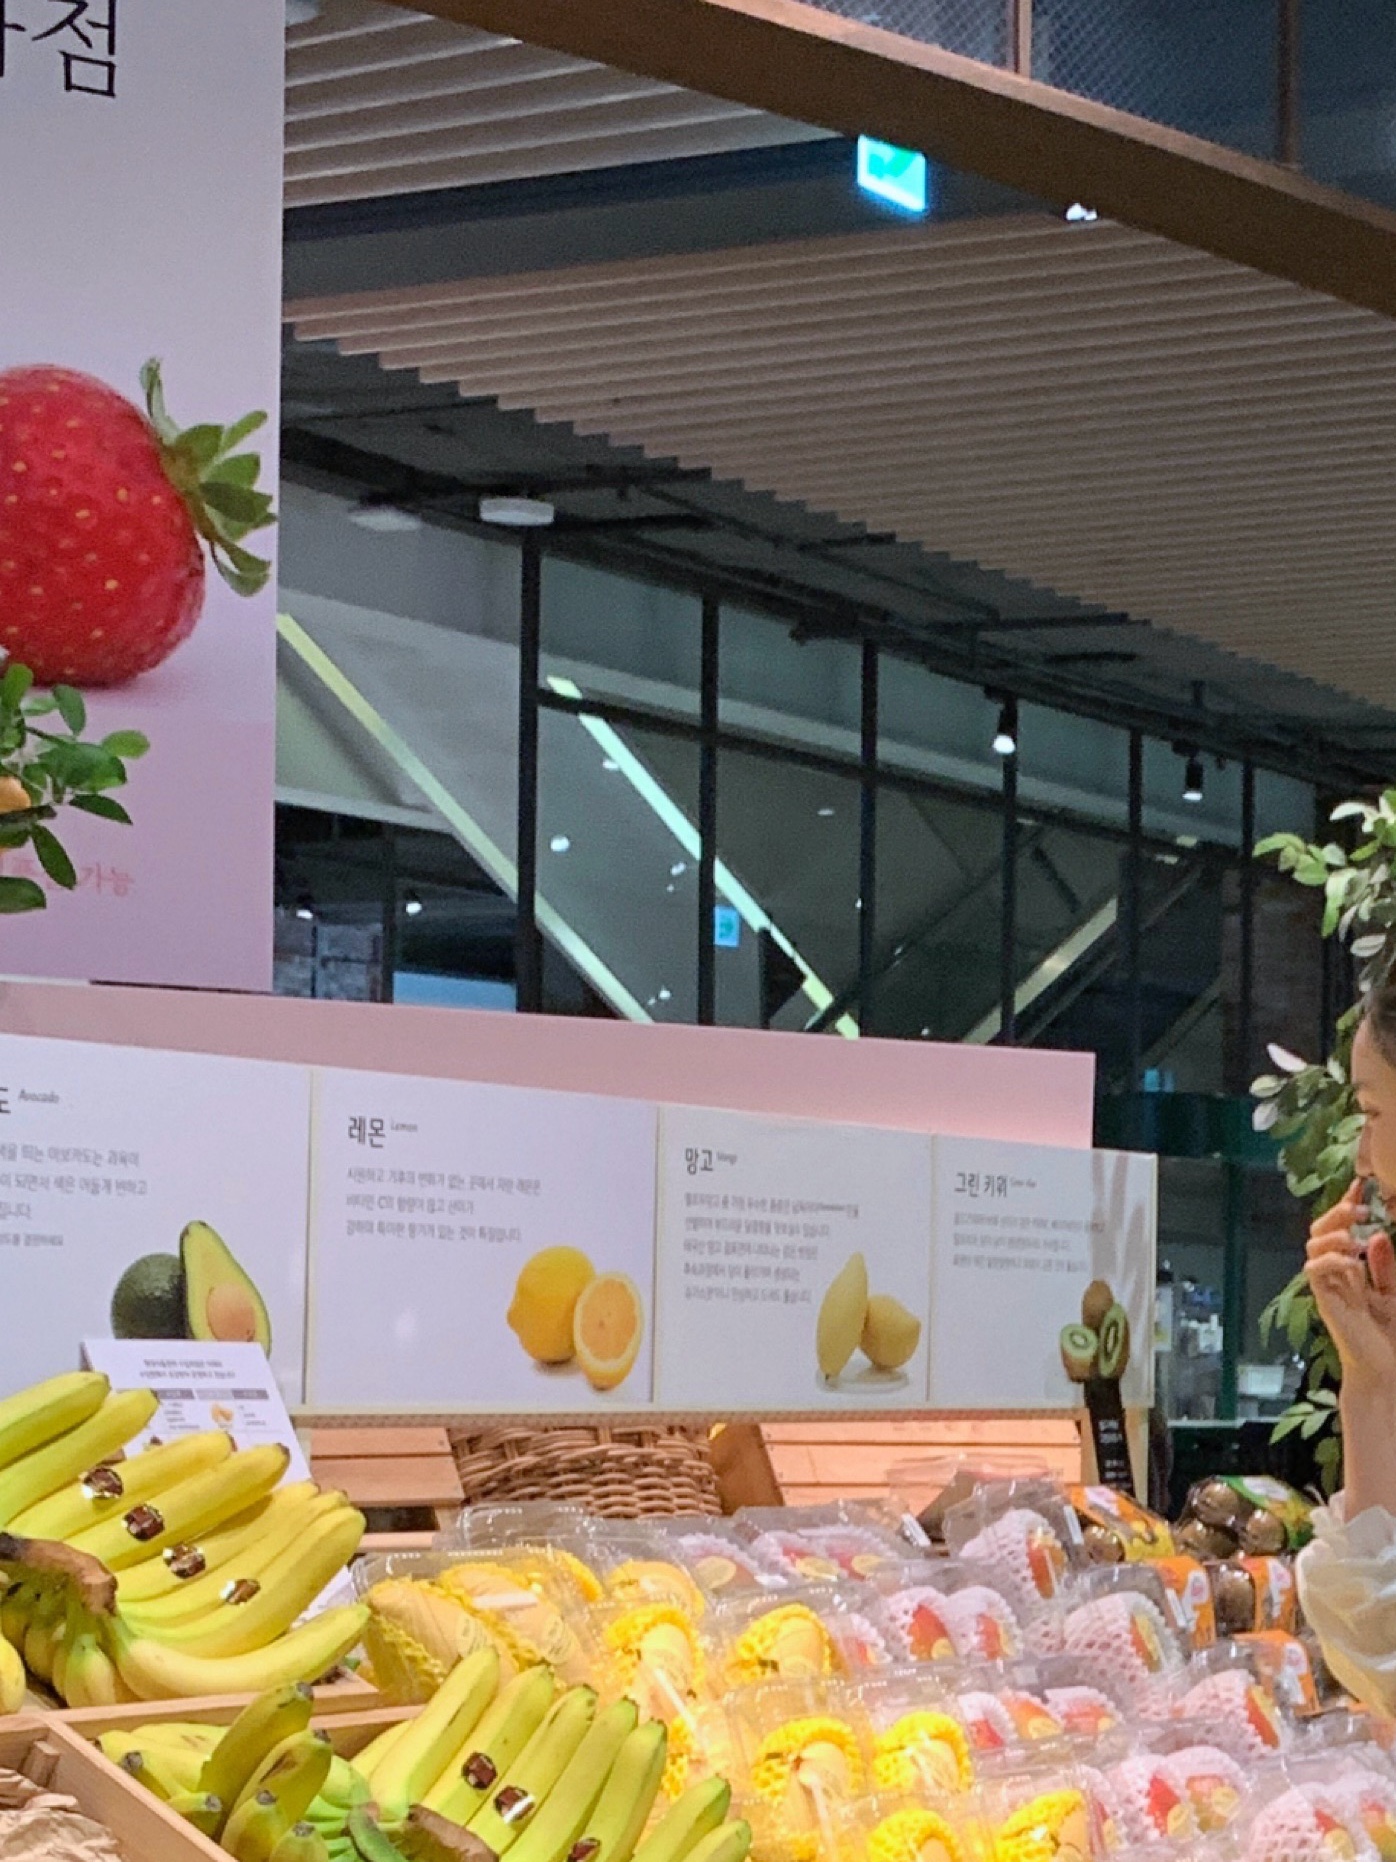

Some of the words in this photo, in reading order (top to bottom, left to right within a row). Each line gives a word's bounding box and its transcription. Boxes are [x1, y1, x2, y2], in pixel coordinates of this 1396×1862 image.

[347, 1116, 386, 1149] 레몬
[685, 1147, 713, 1175] 망고
[954, 1172, 980, 1198] 그린
[984, 1175, 1007, 1198] 키위
